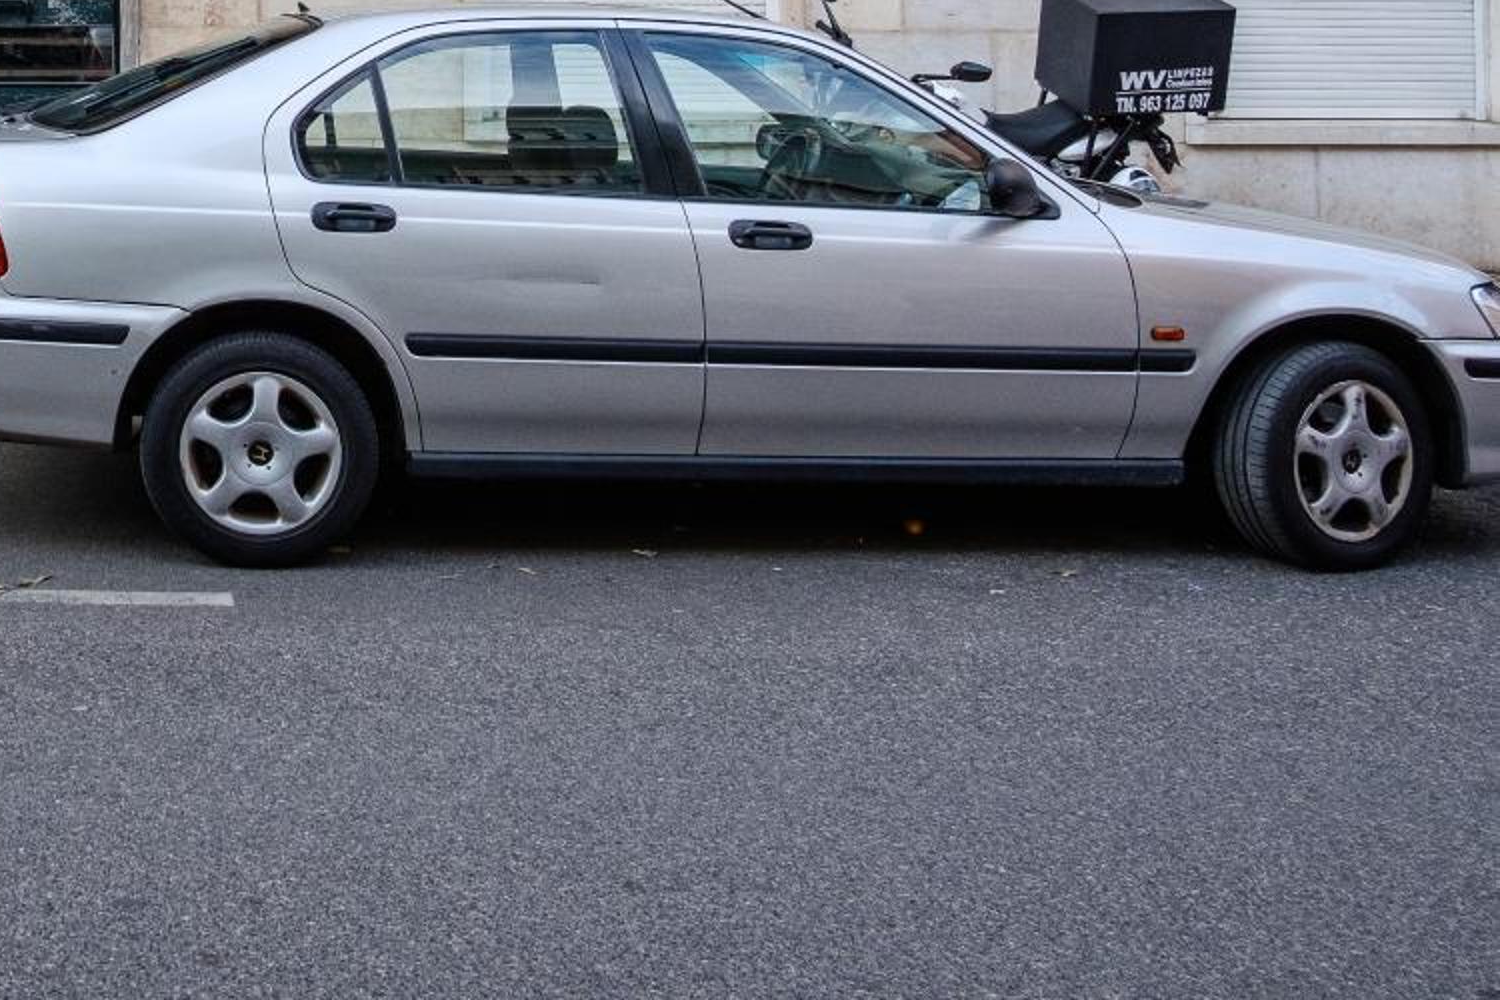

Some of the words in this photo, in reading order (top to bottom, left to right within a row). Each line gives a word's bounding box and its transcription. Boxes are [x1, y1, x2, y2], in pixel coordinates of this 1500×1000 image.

[1119, 69, 1167, 91] WV
[1140, 95, 1161, 112] 963
[1165, 94, 1186, 110] 125
[1188, 92, 1211, 109] 097
